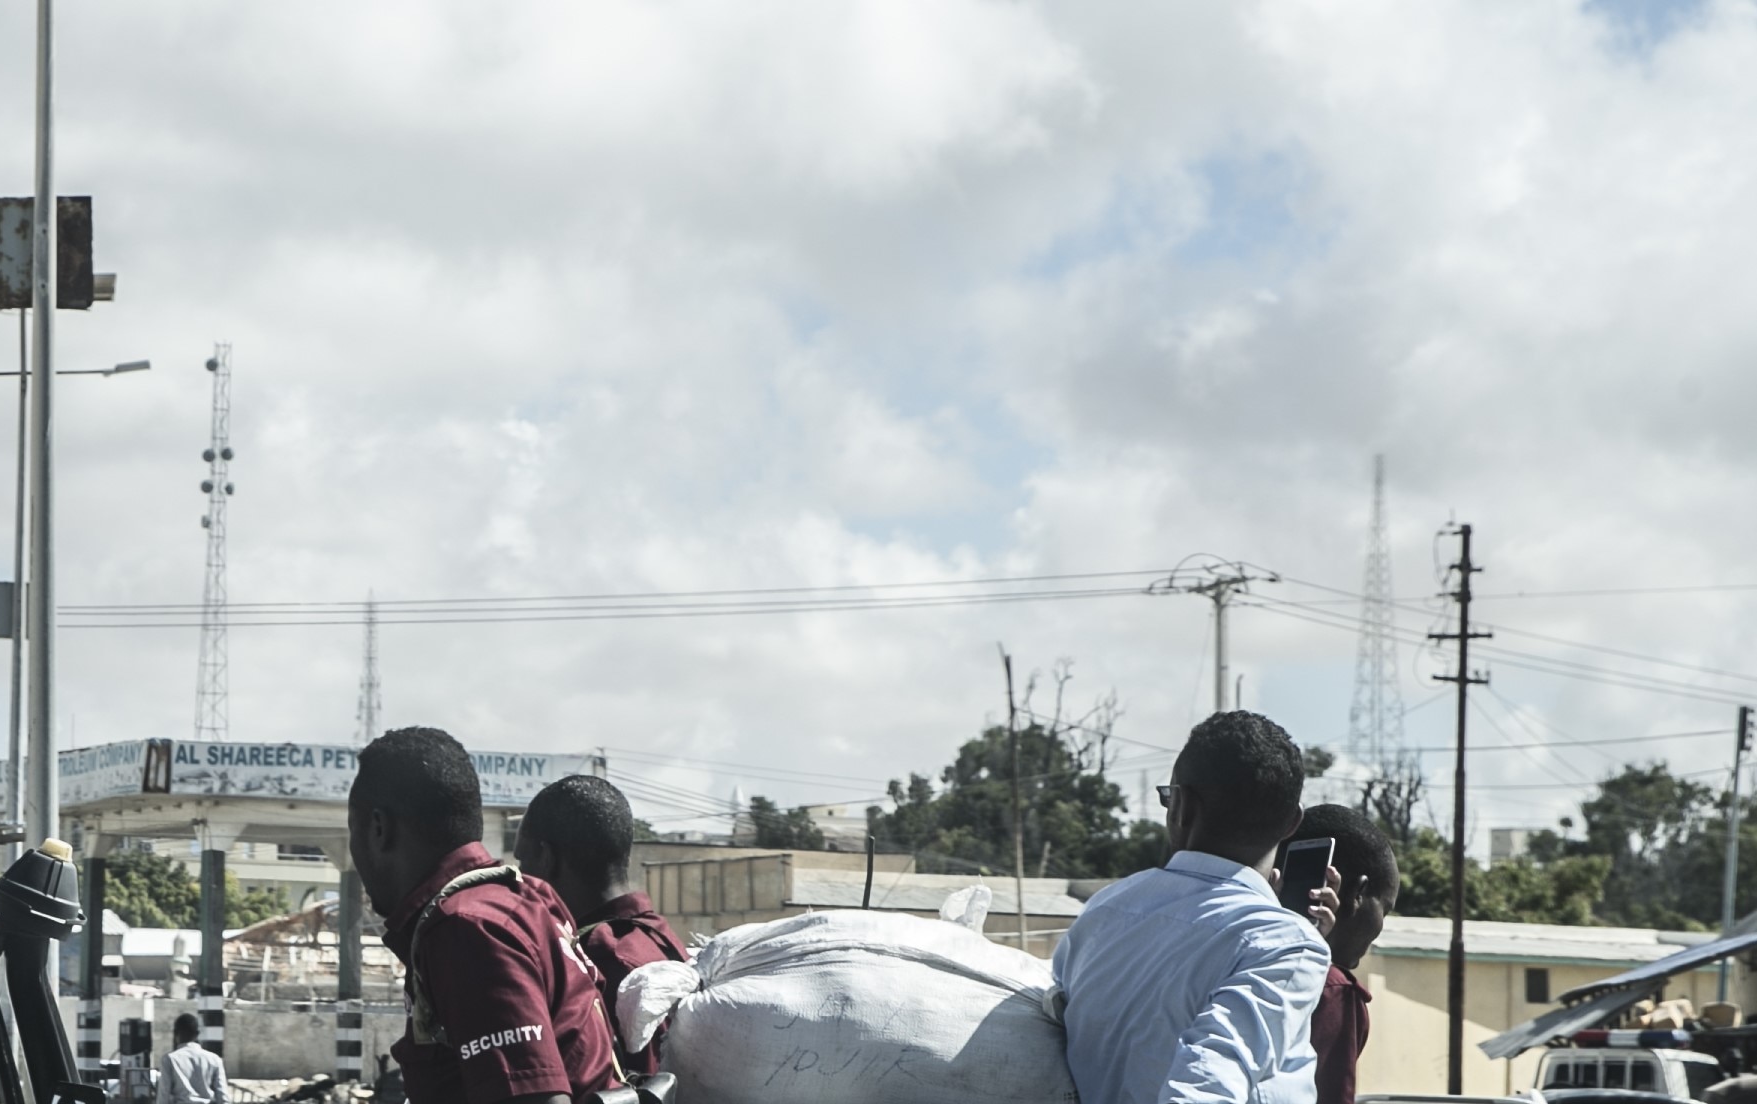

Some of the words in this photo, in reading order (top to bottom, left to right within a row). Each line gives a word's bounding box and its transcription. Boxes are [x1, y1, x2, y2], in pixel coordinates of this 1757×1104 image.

[175, 744, 200, 765] AL
[207, 746, 315, 768] SHAREECA
[322, 749, 358, 769] PET
[469, 755, 546, 776] OMPANY
[460, 1024, 543, 1060] SECURITY
